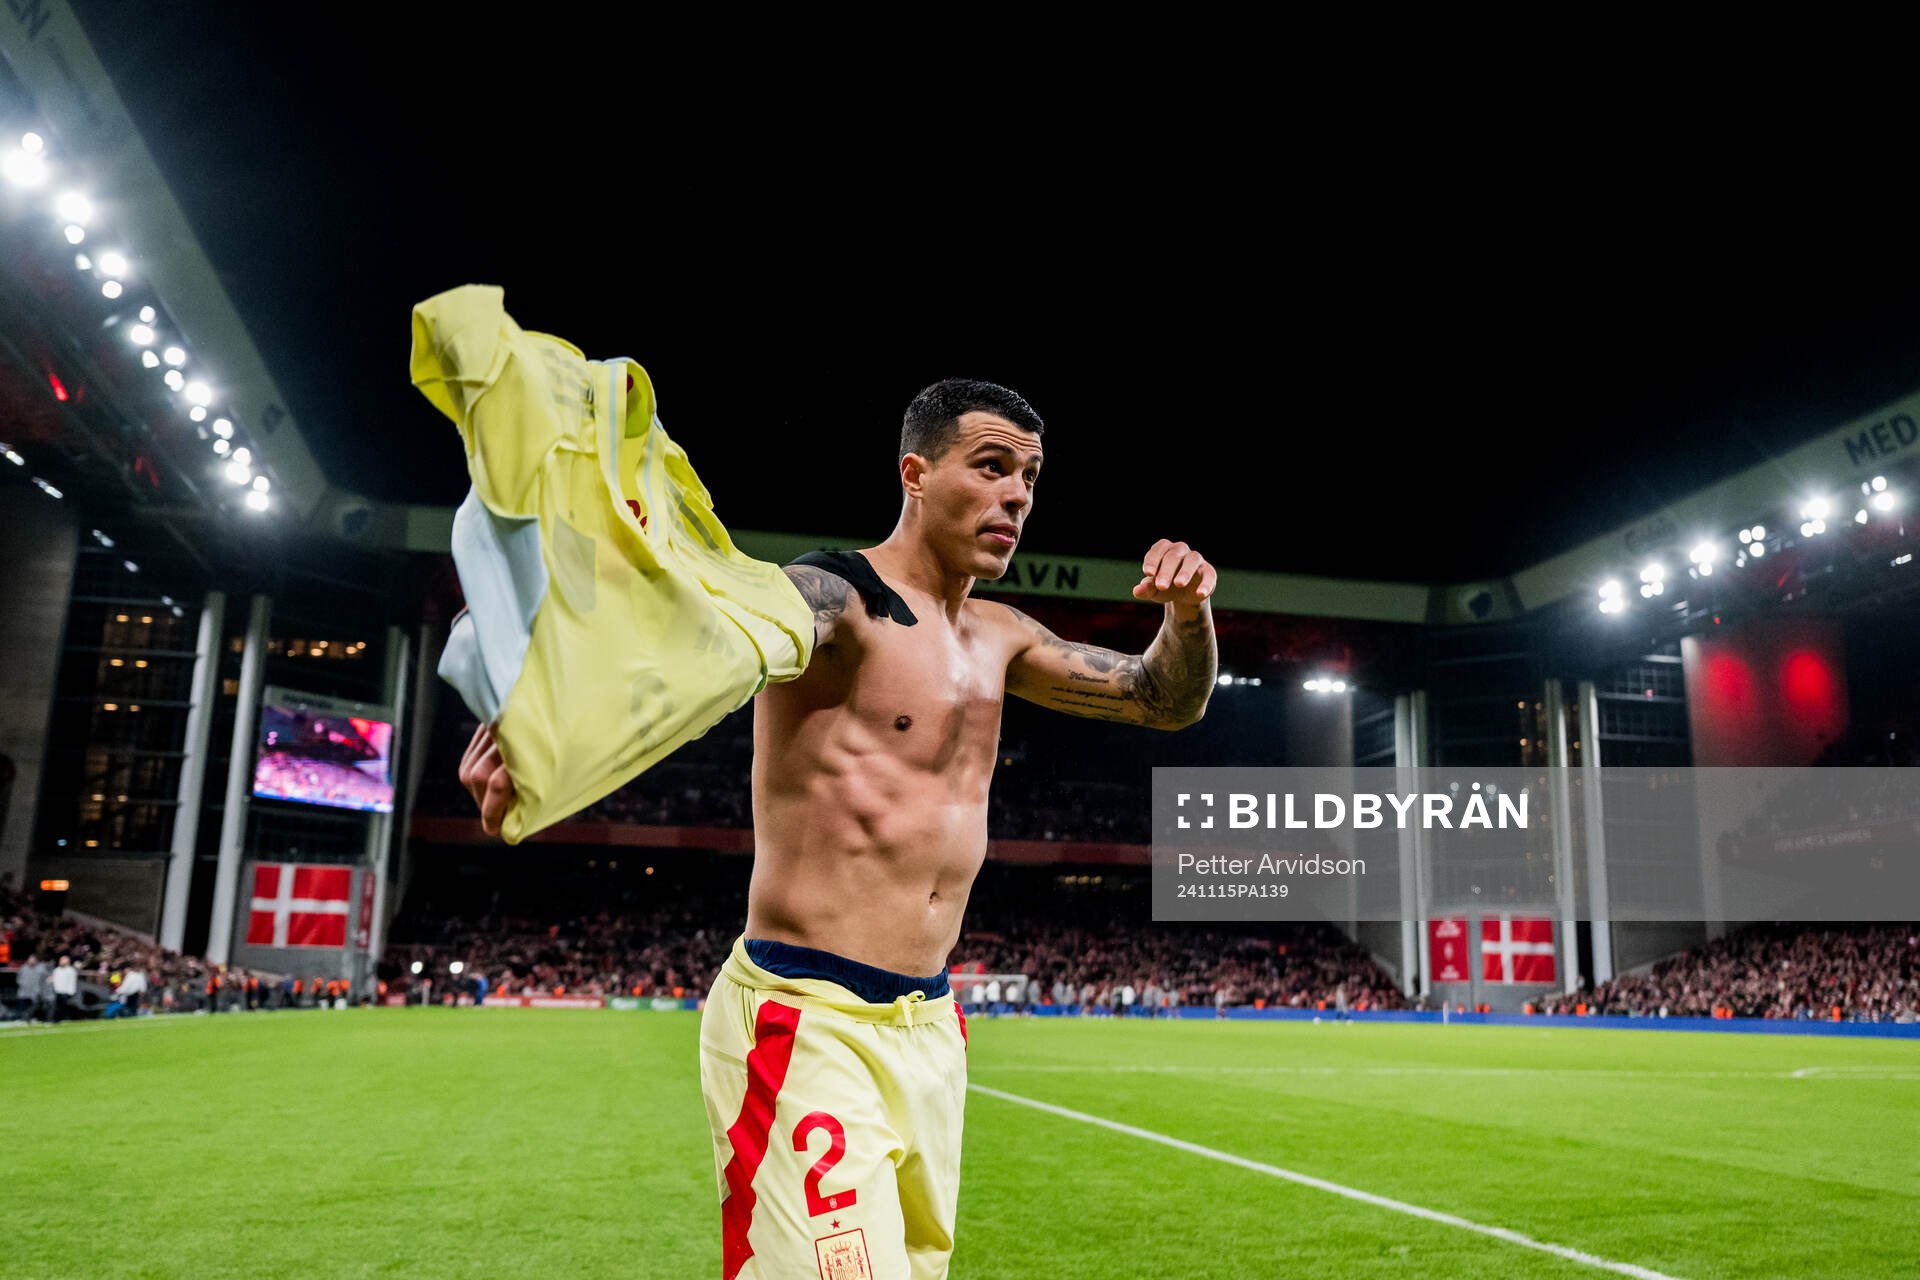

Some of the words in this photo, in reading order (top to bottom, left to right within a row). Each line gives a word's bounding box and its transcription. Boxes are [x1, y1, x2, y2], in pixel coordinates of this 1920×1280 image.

[1843, 414, 1918, 465] MED
[982, 561, 1080, 590] AVN
[792, 1110, 857, 1218] 2
